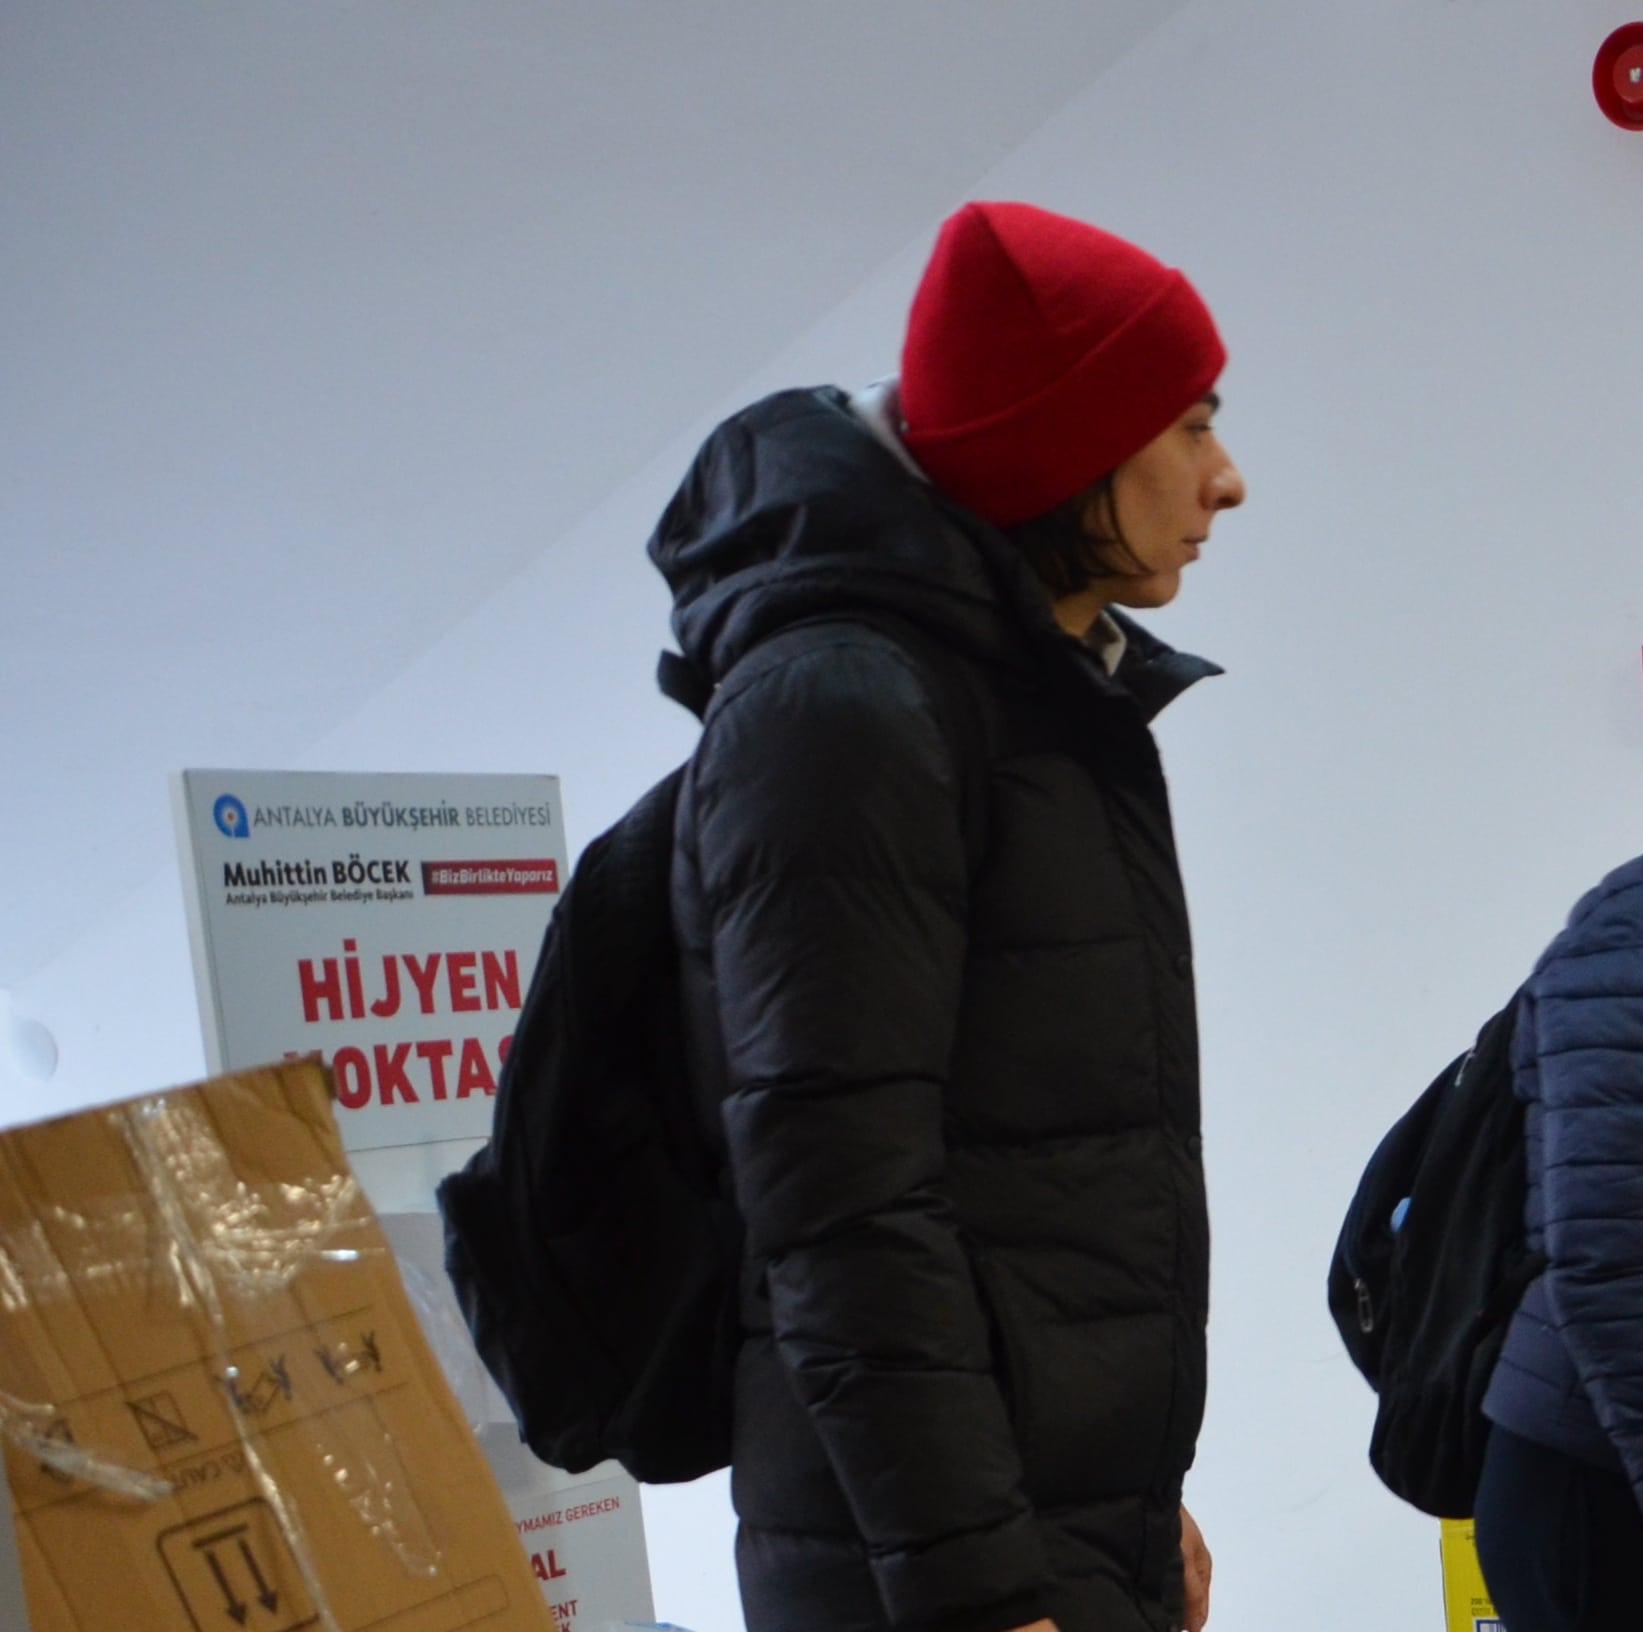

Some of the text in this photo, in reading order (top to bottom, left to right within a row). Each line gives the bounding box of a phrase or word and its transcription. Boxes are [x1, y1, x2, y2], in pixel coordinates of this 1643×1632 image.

[254, 799, 552, 832] ANTALYA BÜYÜKŞEHİR BELEDİYESİ
[223, 852, 553, 887] Muhittin BÖCEK #BizBirlikteYaparız
[298, 938, 522, 1023] HİJYEN
[284, 1034, 512, 1110] OKTA
[565, 1496, 621, 1522] GEREKEN
